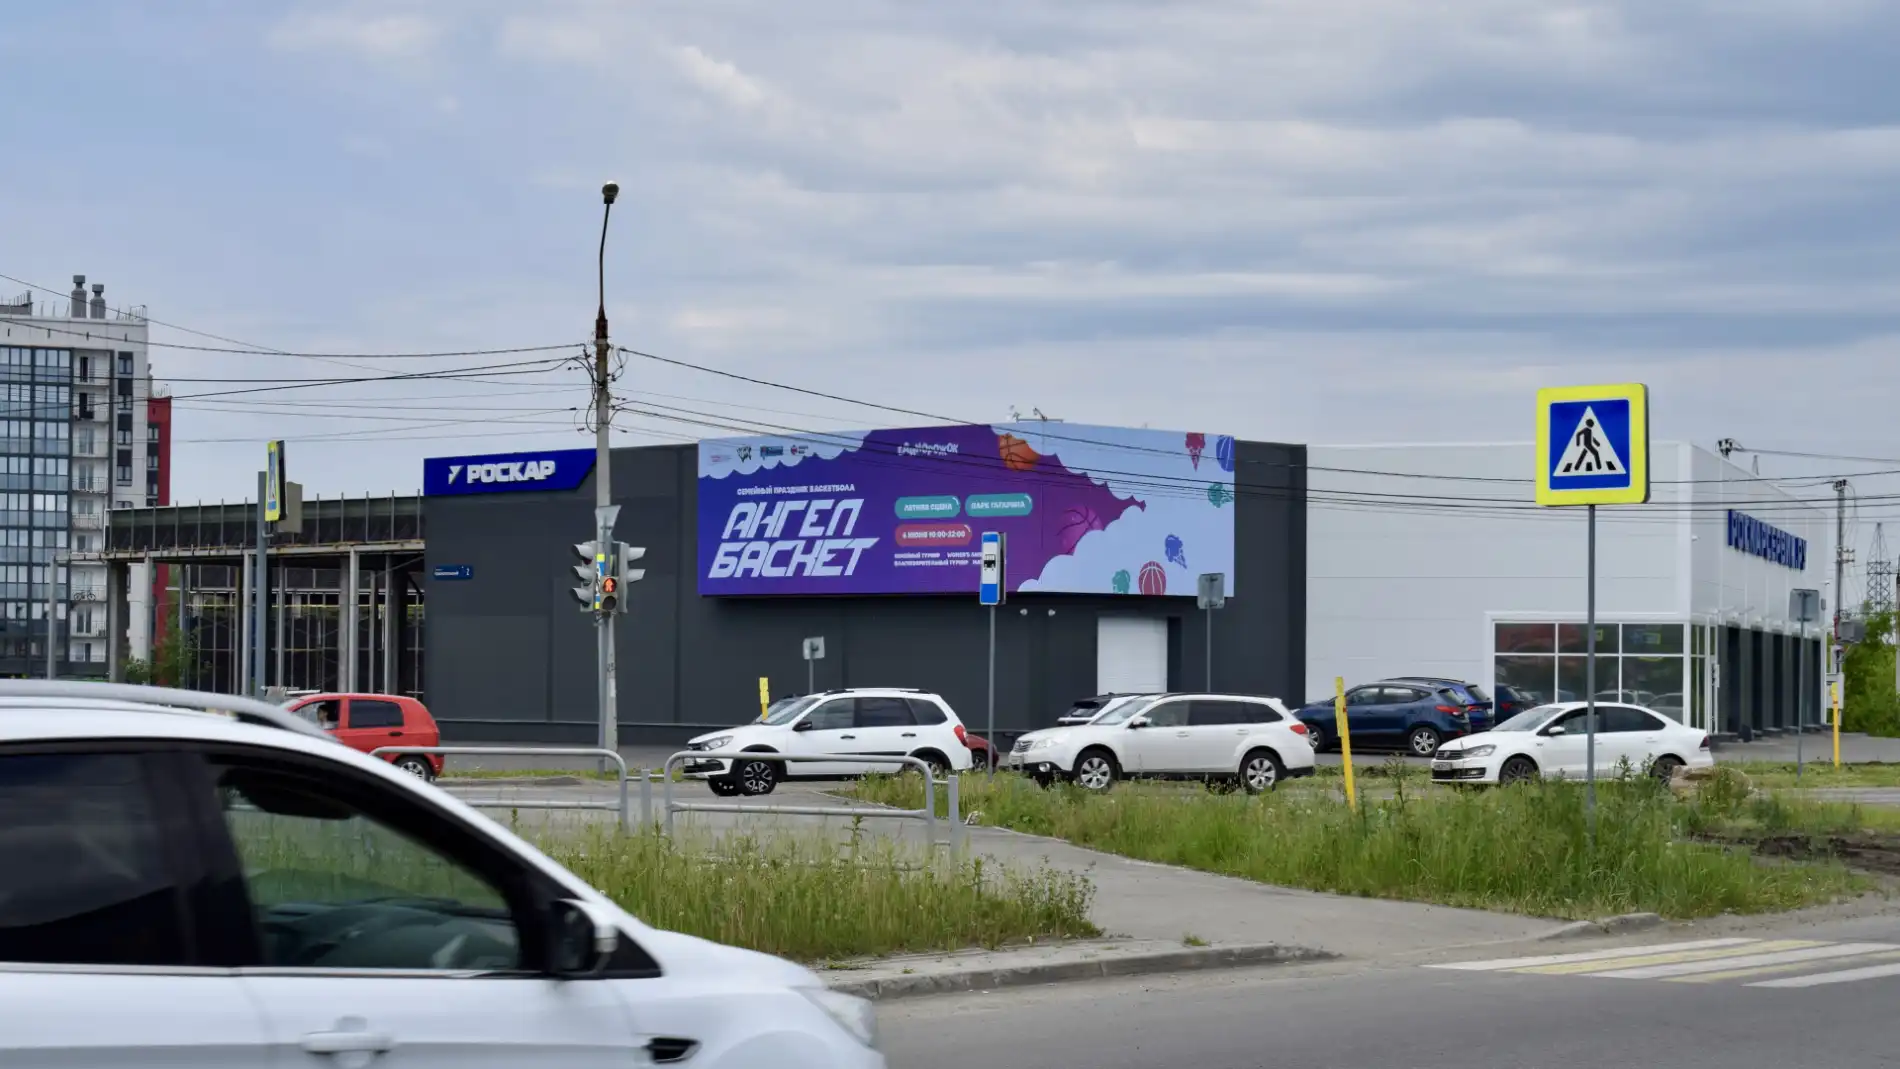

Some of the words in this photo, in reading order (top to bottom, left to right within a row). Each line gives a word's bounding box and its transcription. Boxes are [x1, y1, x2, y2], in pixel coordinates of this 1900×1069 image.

[467, 460, 556, 484] РОСКАР
[736, 485, 773, 496] СЕМЕЙНЫЙ
[773, 485, 809, 495] ПРАЗДНИК
[809, 483, 856, 493] БАСКЕТБОЛА
[971, 501, 990, 510] ПАРК
[721, 498, 865, 540] АНГЕЛ
[707, 537, 881, 579] БАСКЕТ
